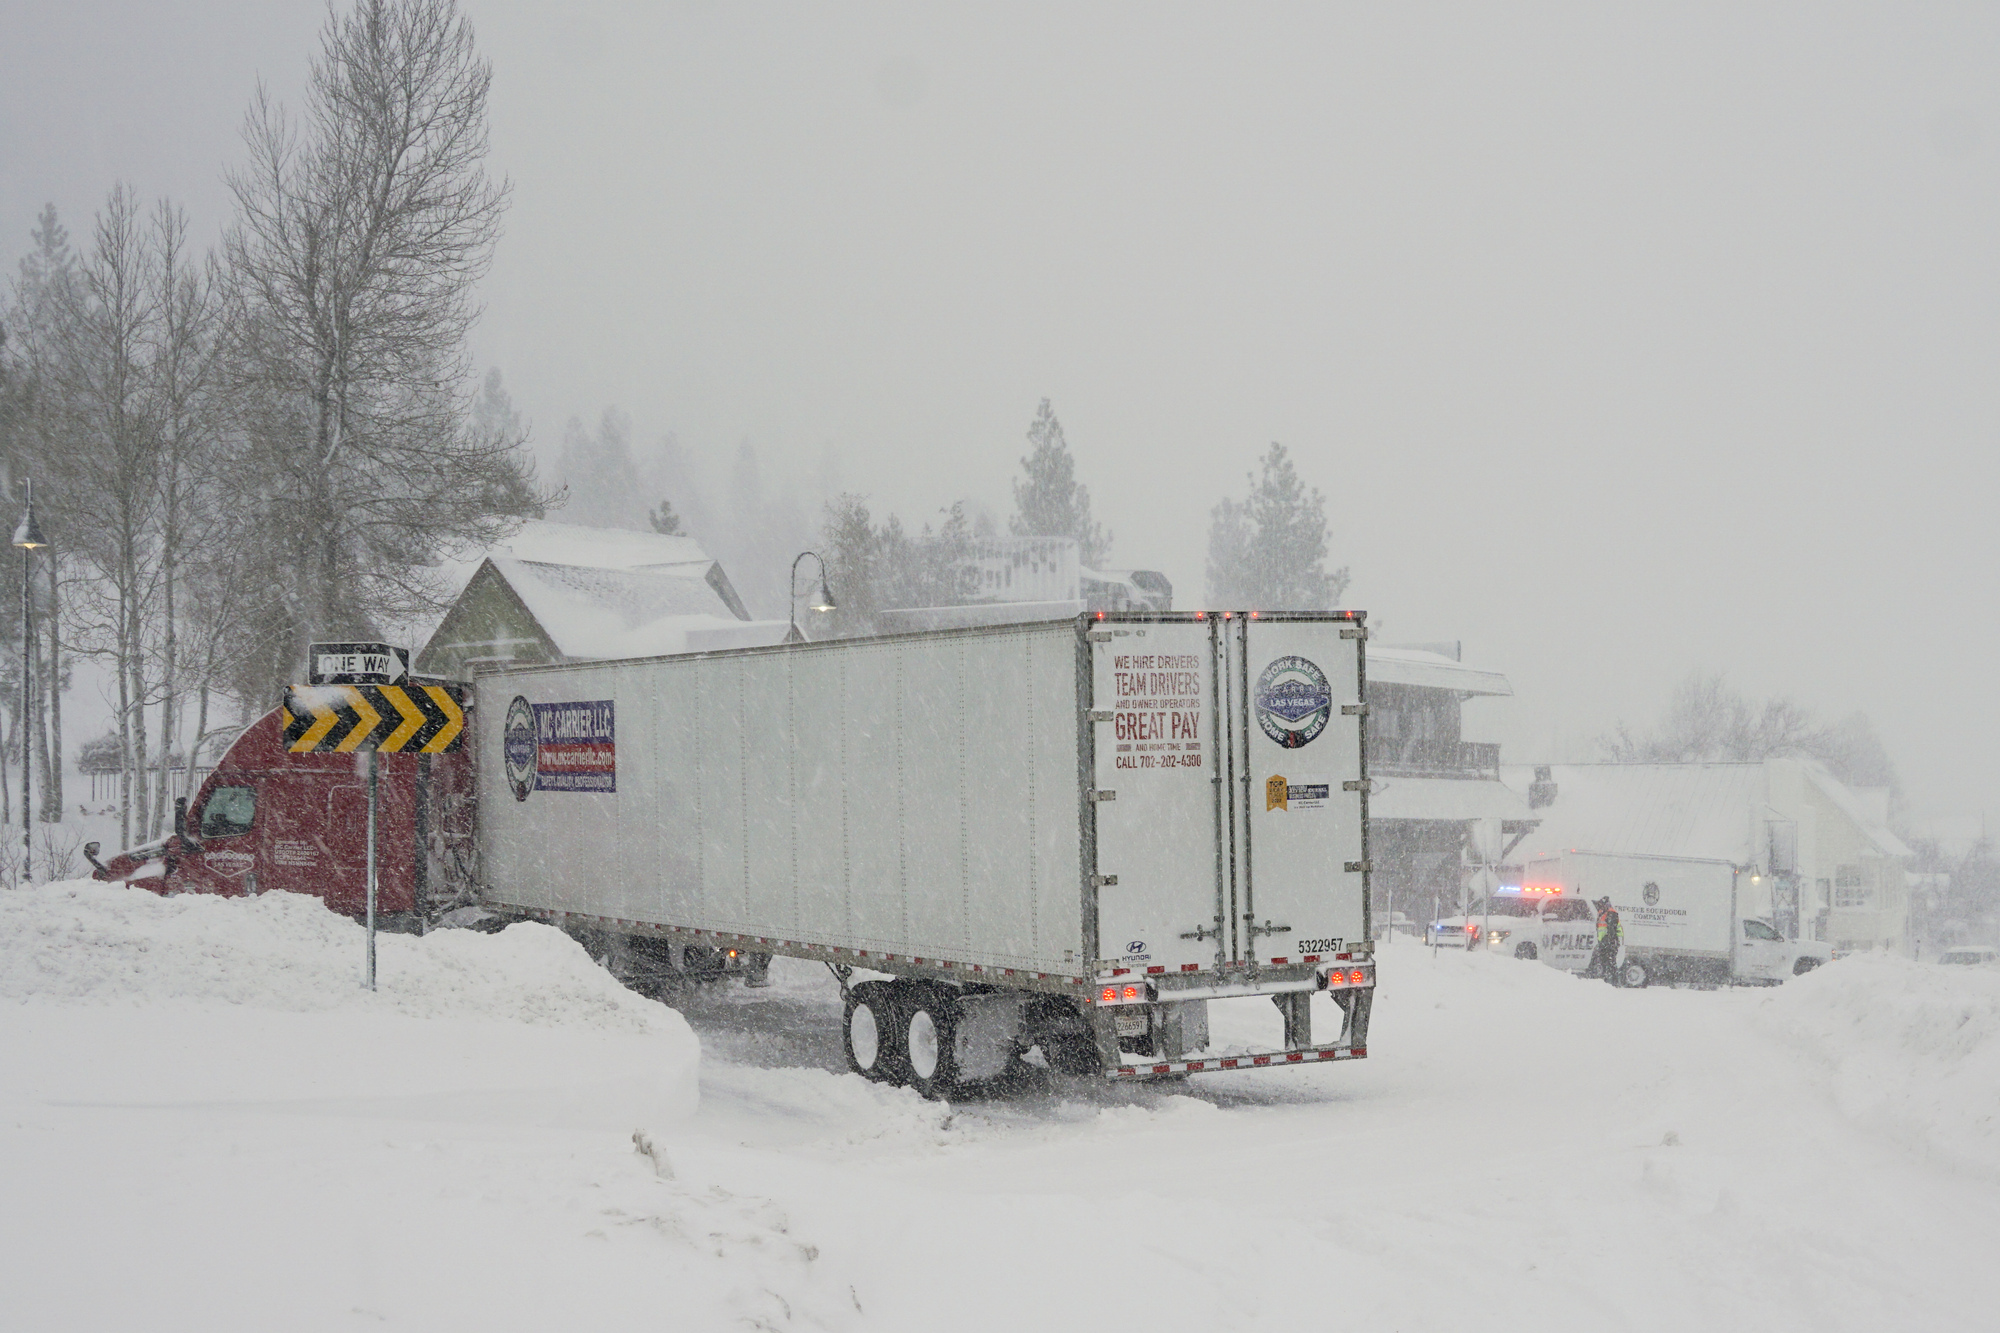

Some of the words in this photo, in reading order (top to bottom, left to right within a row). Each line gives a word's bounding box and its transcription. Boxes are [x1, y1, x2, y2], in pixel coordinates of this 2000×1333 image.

[323, 656, 357, 672] ONE
[363, 656, 390, 673] WAY
[1115, 656, 1130, 669] WE
[1133, 656, 1155, 669] HIRE
[1158, 655, 1200, 668] DRIVERS
[1264, 659, 1292, 682] WORK
[1295, 660, 1321, 680] SAFE
[1115, 673, 1146, 696] TEAM
[1150, 672, 1200, 696] DRIVERS
[1115, 699, 1130, 709] AND
[1132, 699, 1158, 709] OWNER
[1160, 698, 1200, 708] OPERATORS
[1271, 699, 1286, 707] LAS
[1287, 698, 1315, 707] VEGAS
[540, 711, 554, 738] MC
[555, 709, 591, 738] CARRIER
[594, 708, 611, 737] LLC
[1115, 712, 1166, 740] GREAT
[1171, 711, 1200, 740] PAY
[1260, 715, 1285, 741] HOME
[1304, 715, 1326, 740] SAFE
[1136, 743, 1148, 752] AND
[1167, 743, 1181, 751] TIME
[1116, 756, 1138, 769] CALL
[1633, 913, 1667, 921] COMPANY
[1646, 907, 1687, 916] SOURDOUGH
[1299, 938, 1344, 954] 5322957
[1550, 934, 1594, 950] POLICE
[1122, 954, 1152, 962] HYUNDAI
